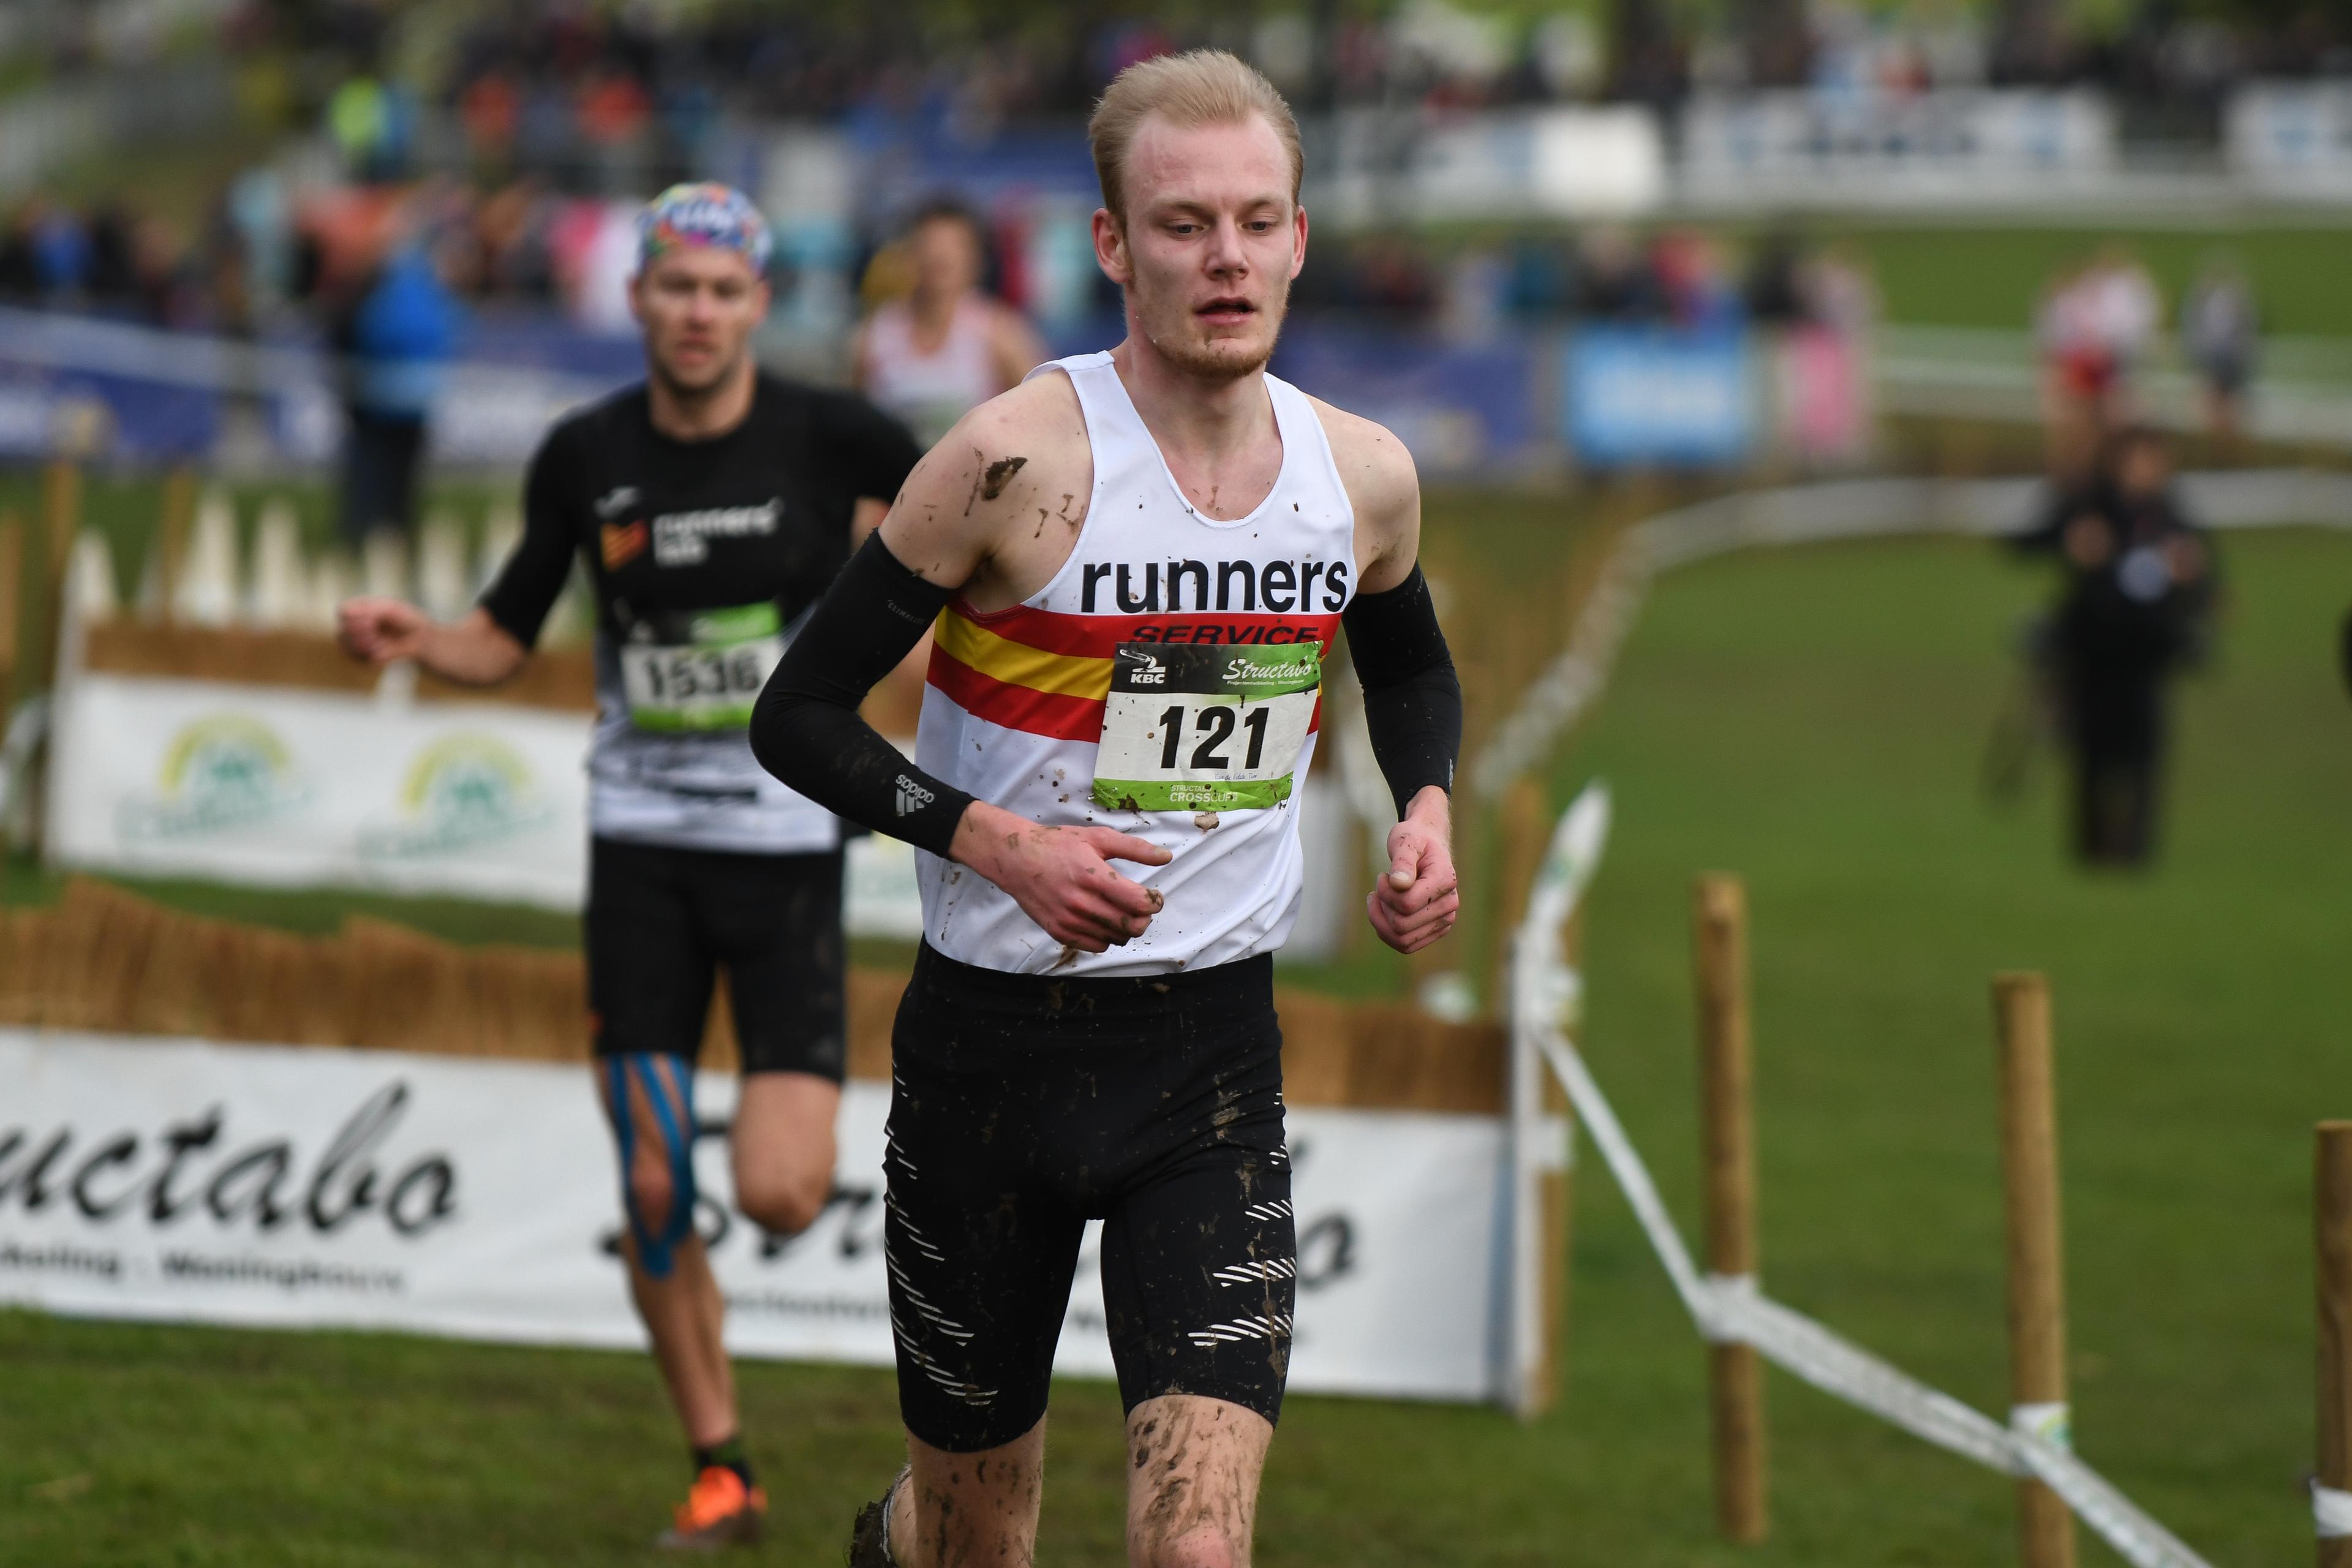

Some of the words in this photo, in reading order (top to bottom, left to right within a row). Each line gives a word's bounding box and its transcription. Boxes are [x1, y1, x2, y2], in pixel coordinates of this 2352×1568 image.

[1080, 559, 1348, 613] runners
[887, 599, 925, 624] CLIMALIT
[1129, 625, 1319, 645] SERVICE
[1130, 673, 1165, 684] KBC
[1221, 655, 1312, 680] Structabo
[1159, 705, 1270, 769] 121
[895, 774, 934, 803] adidas
